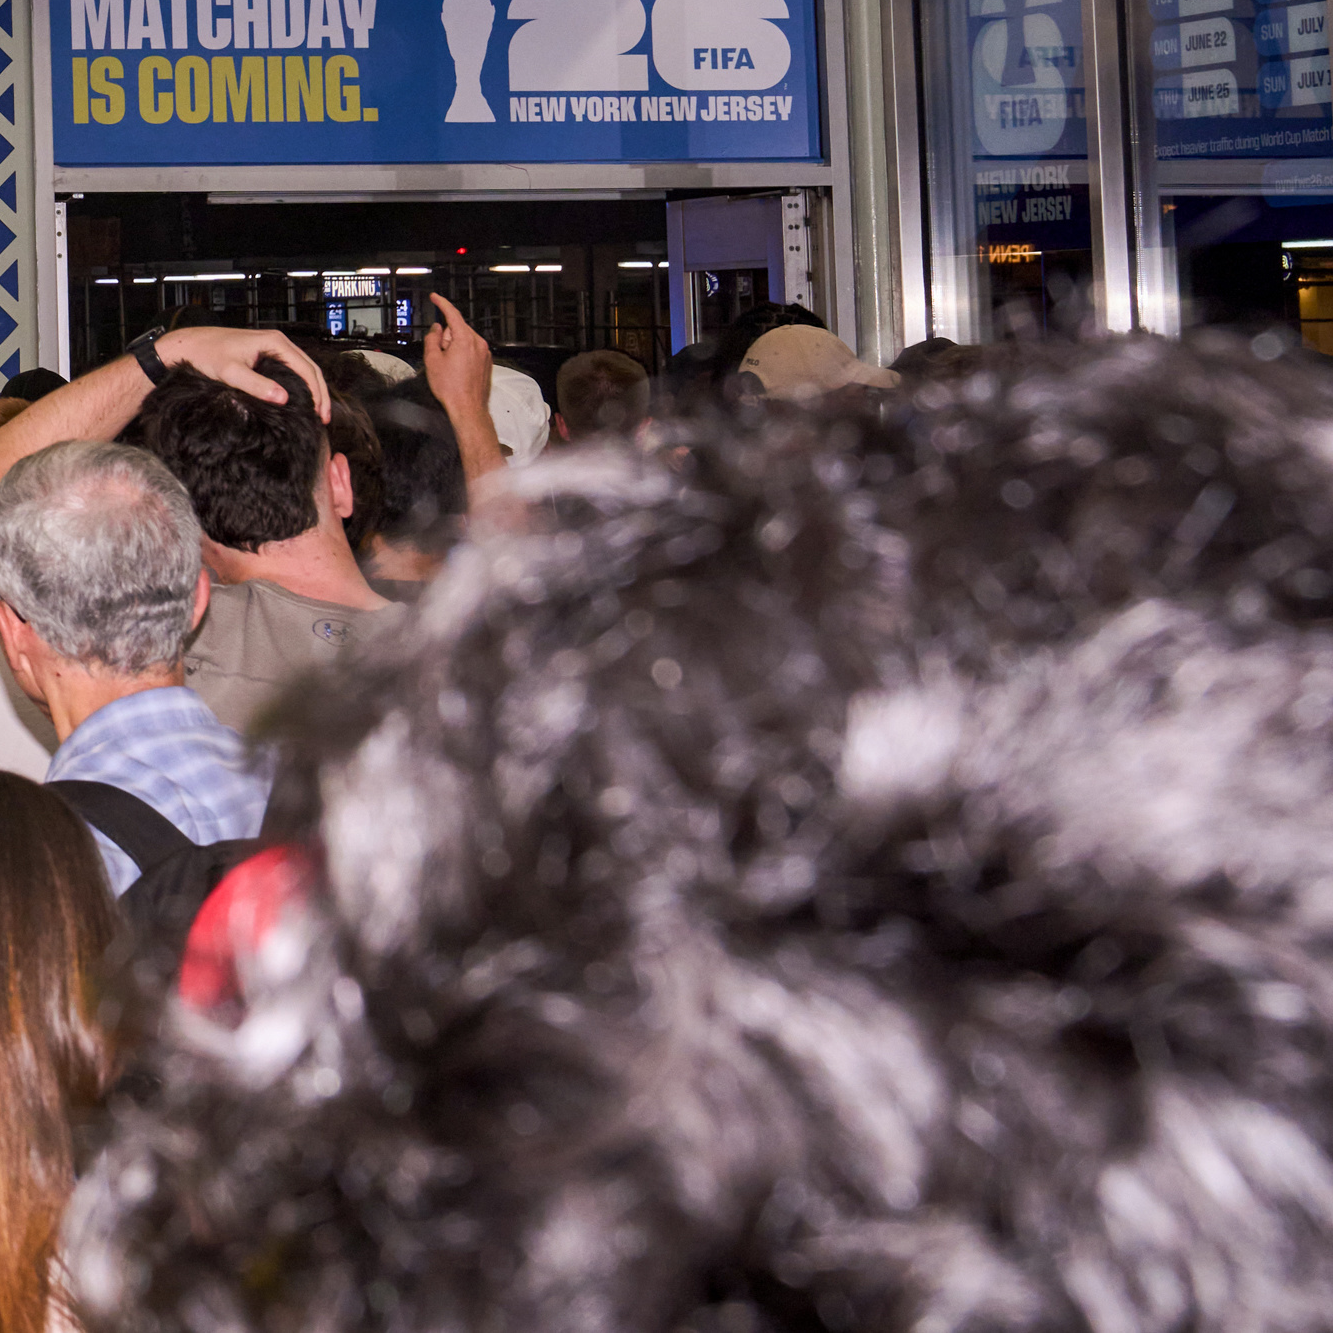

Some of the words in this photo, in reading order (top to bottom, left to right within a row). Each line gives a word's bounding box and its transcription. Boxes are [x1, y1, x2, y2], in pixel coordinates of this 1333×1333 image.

[1261, 23, 1283, 40] SUN
[1298, 16, 1324, 35] JULY
[1154, 39, 1178, 55] MON
[1185, 34, 1212, 51] JUNE
[1214, 31, 1227, 47] 22
[694, 47, 755, 70] FIFA
[72, 56, 125, 124] IS
[138, 55, 378, 124] COMING.
[1264, 76, 1285, 92] SUN
[1298, 70, 1325, 89] JULY
[1158, 90, 1178, 105] THU
[1188, 85, 1214, 102] JUNE
[1217, 83, 1229, 98] 25
[510, 97, 566, 122] NEW
[570, 96, 636, 122] YORK
[641, 96, 697, 121] NEW
[699, 96, 792, 121] JERSEY
[1000, 98, 1042, 129] FIFA
[1153, 144, 1180, 159] Expect
[1181, 141, 1209, 154] heavier
[1210, 137, 1234, 152] traffic
[1235, 135, 1259, 150] during
[1261, 131, 1284, 146] World
[1285, 131, 1301, 147] Cup
[1302, 127, 1330, 142] Match
[976, 169, 1016, 196] NEW
[1020, 164, 1070, 192] YORK
[978, 199, 1018, 225] NEW
[1022, 195, 1071, 223] JERSEY
[331, 276, 375, 297] PARKING
[330, 321, 343, 336] P
